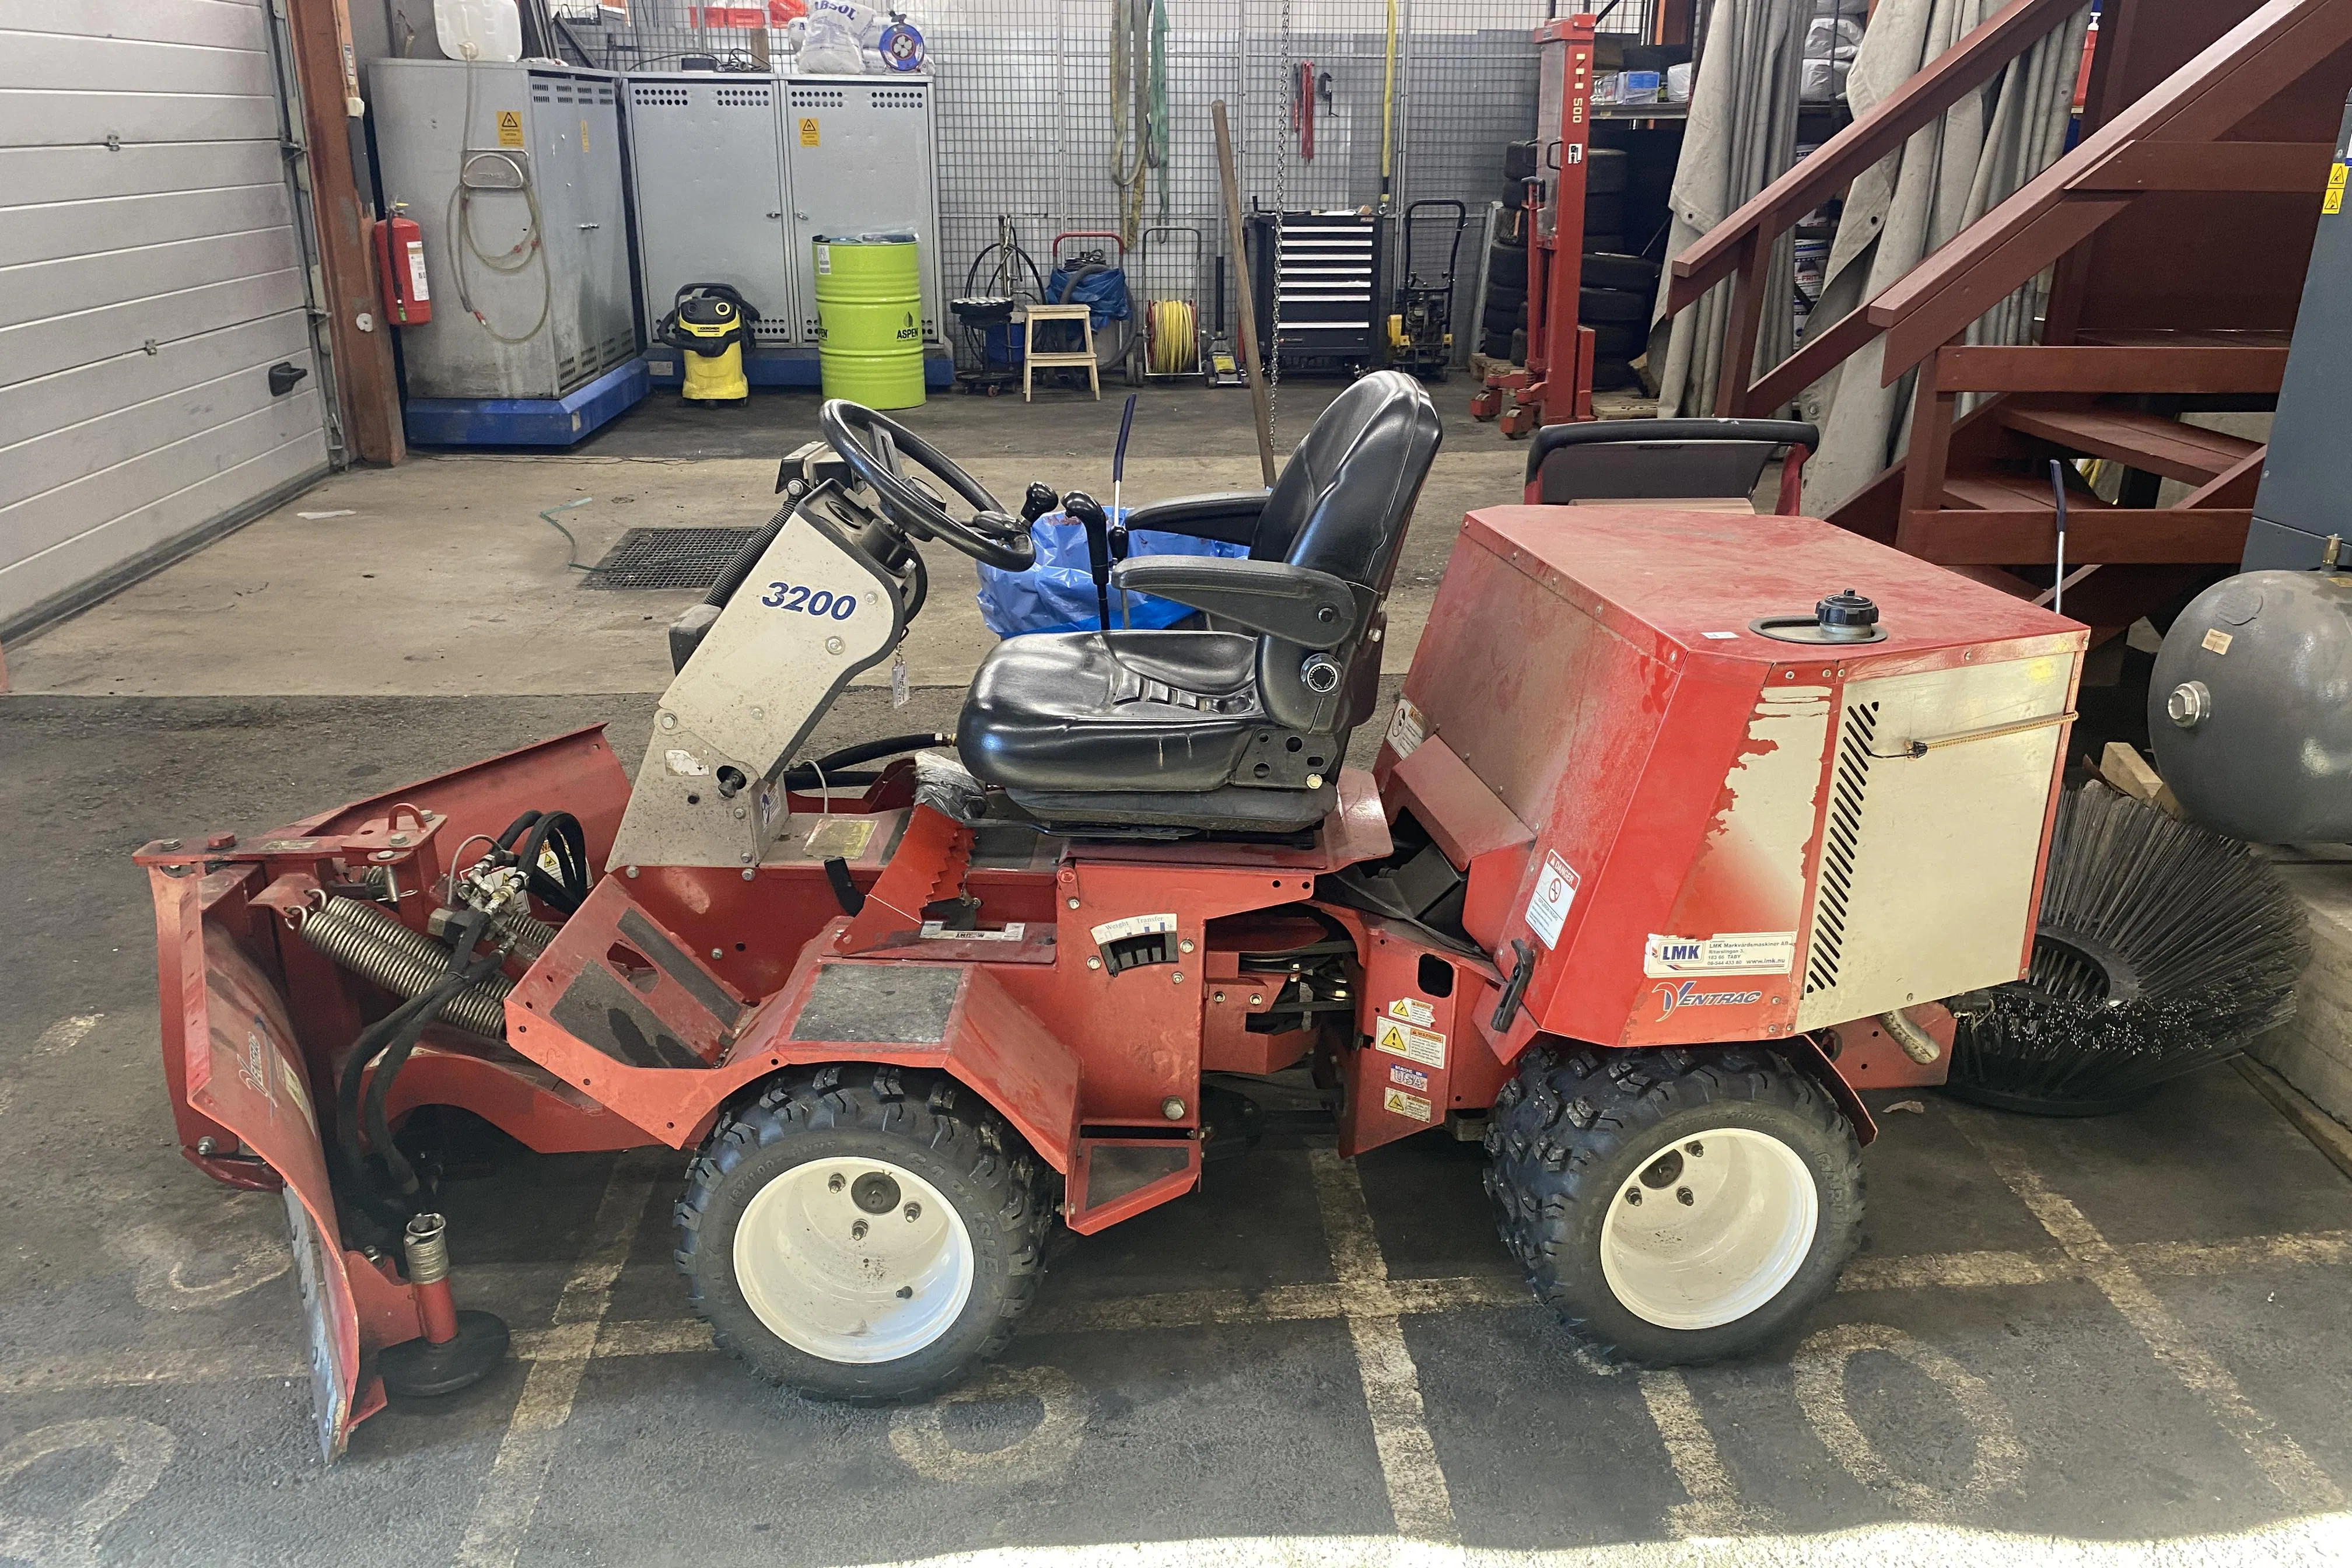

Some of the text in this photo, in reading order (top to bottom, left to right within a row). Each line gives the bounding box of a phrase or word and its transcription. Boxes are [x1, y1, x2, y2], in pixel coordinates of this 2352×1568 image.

[1573, 97, 1583, 123] 500
[897, 327, 919, 340] ASPEN
[762, 582, 857, 621] 3200
[1555, 860, 1574, 885] DANGER
[1105, 915, 1164, 930] Weight Transfer
[1662, 944, 1700, 960] LMK
[1651, 981, 1762, 1022] VENTRAC
[1395, 1065, 1412, 1073] MADE
[1394, 1070, 1424, 1088] USA
